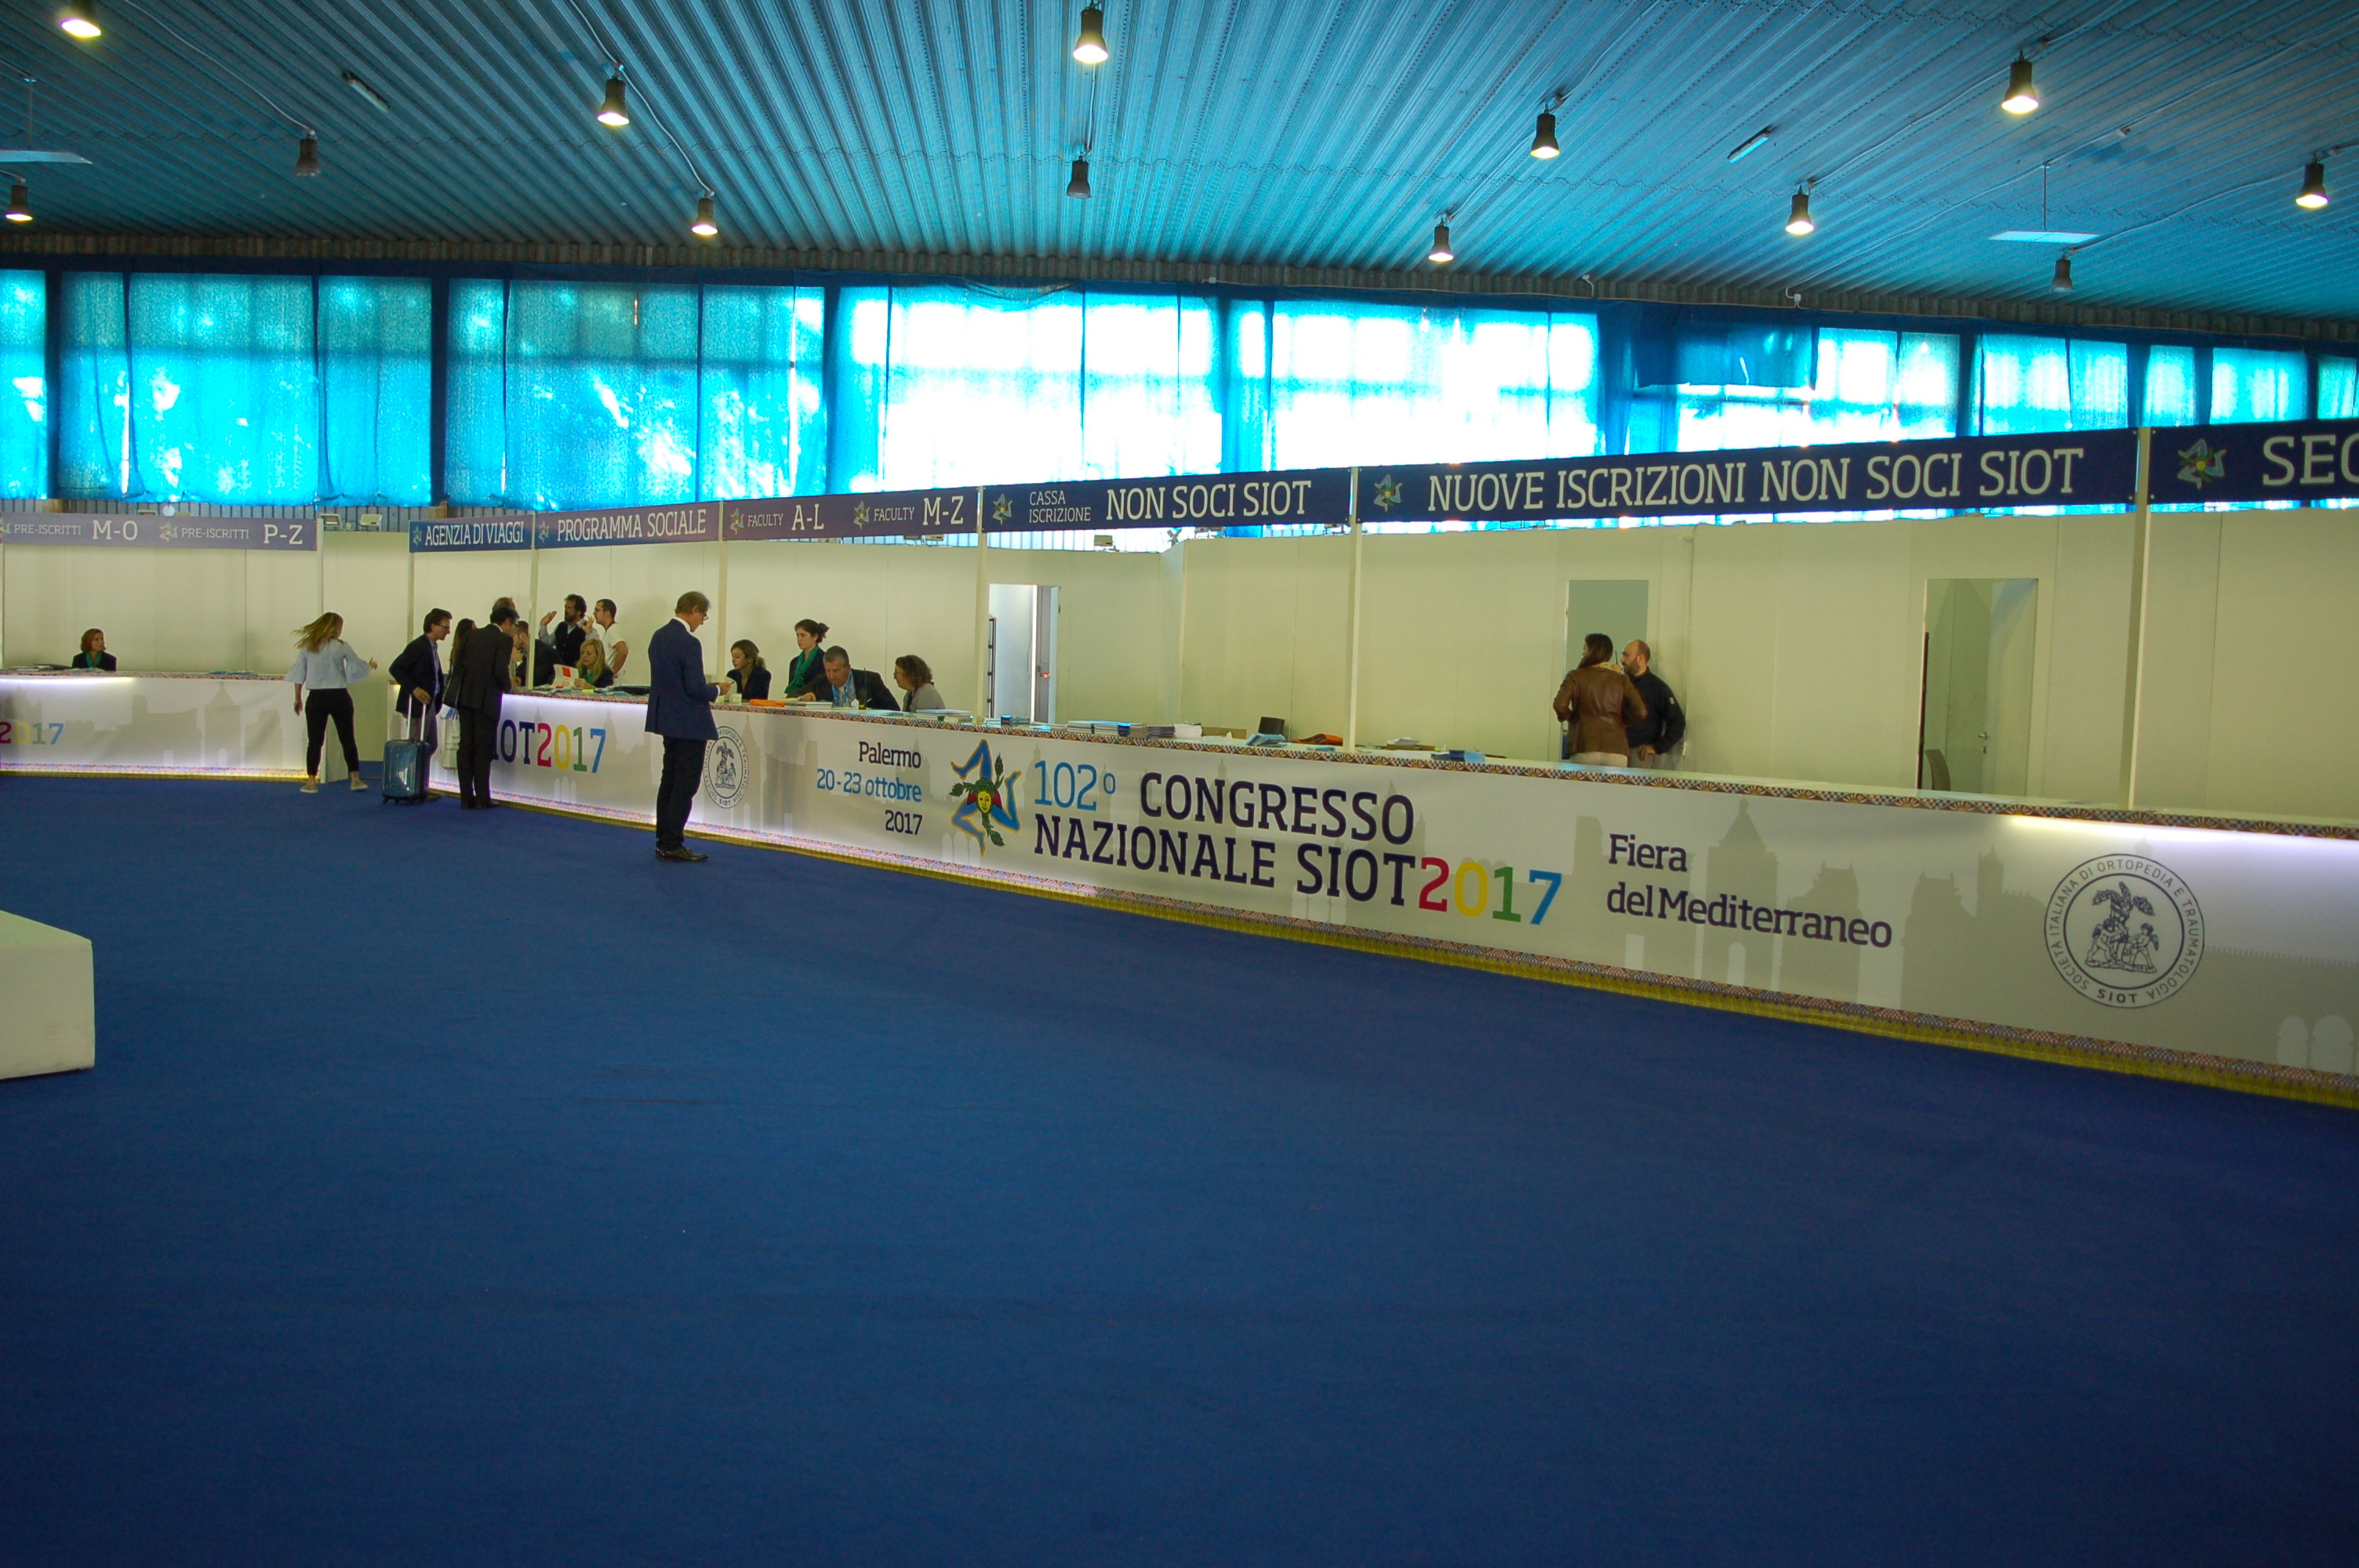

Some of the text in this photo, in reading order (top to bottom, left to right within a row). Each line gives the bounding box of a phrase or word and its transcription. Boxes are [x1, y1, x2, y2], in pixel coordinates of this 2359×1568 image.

[1427, 448, 2085, 512] NUOVE ISCRIZIONI NON SOCI SIOT
[874, 495, 965, 526] FACULTY M-Z
[1029, 490, 1067, 506] CASSA
[1106, 480, 1312, 521] NON SOCI SIOT
[557, 509, 707, 543] PROGRAMMA SOCIALE
[747, 503, 824, 531] FACULTY A-L
[1029, 506, 1092, 524] ISCRIZIONE
[14, 520, 139, 541] PRE-ISCRITTI M-O
[181, 524, 304, 545] PRE-ISCRITTI P-Z
[424, 521, 525, 546] AGENZIA DI VIAGGI
[0, 721, 64, 745] 2017
[859, 741, 921, 769] Palermo
[865, 777, 922, 802] ottobre
[1140, 771, 1415, 845] CONGRESSO
[885, 810, 923, 836] 2017
[1034, 813, 1276, 889] NAZIONALE
[1608, 833, 1688, 873] Fiera
[2078, 867, 2094, 881] DI
[2096, 858, 2174, 888] ORTOPEDIA
[2172, 887, 2185, 898] E
[1606, 881, 1892, 949] del Mediterraneo
[2049, 880, 2078, 936] ITALIANA
[2146, 898, 2200, 1000] TRAUMATOLOGIA
[2096, 989, 2138, 1004] SIOT
